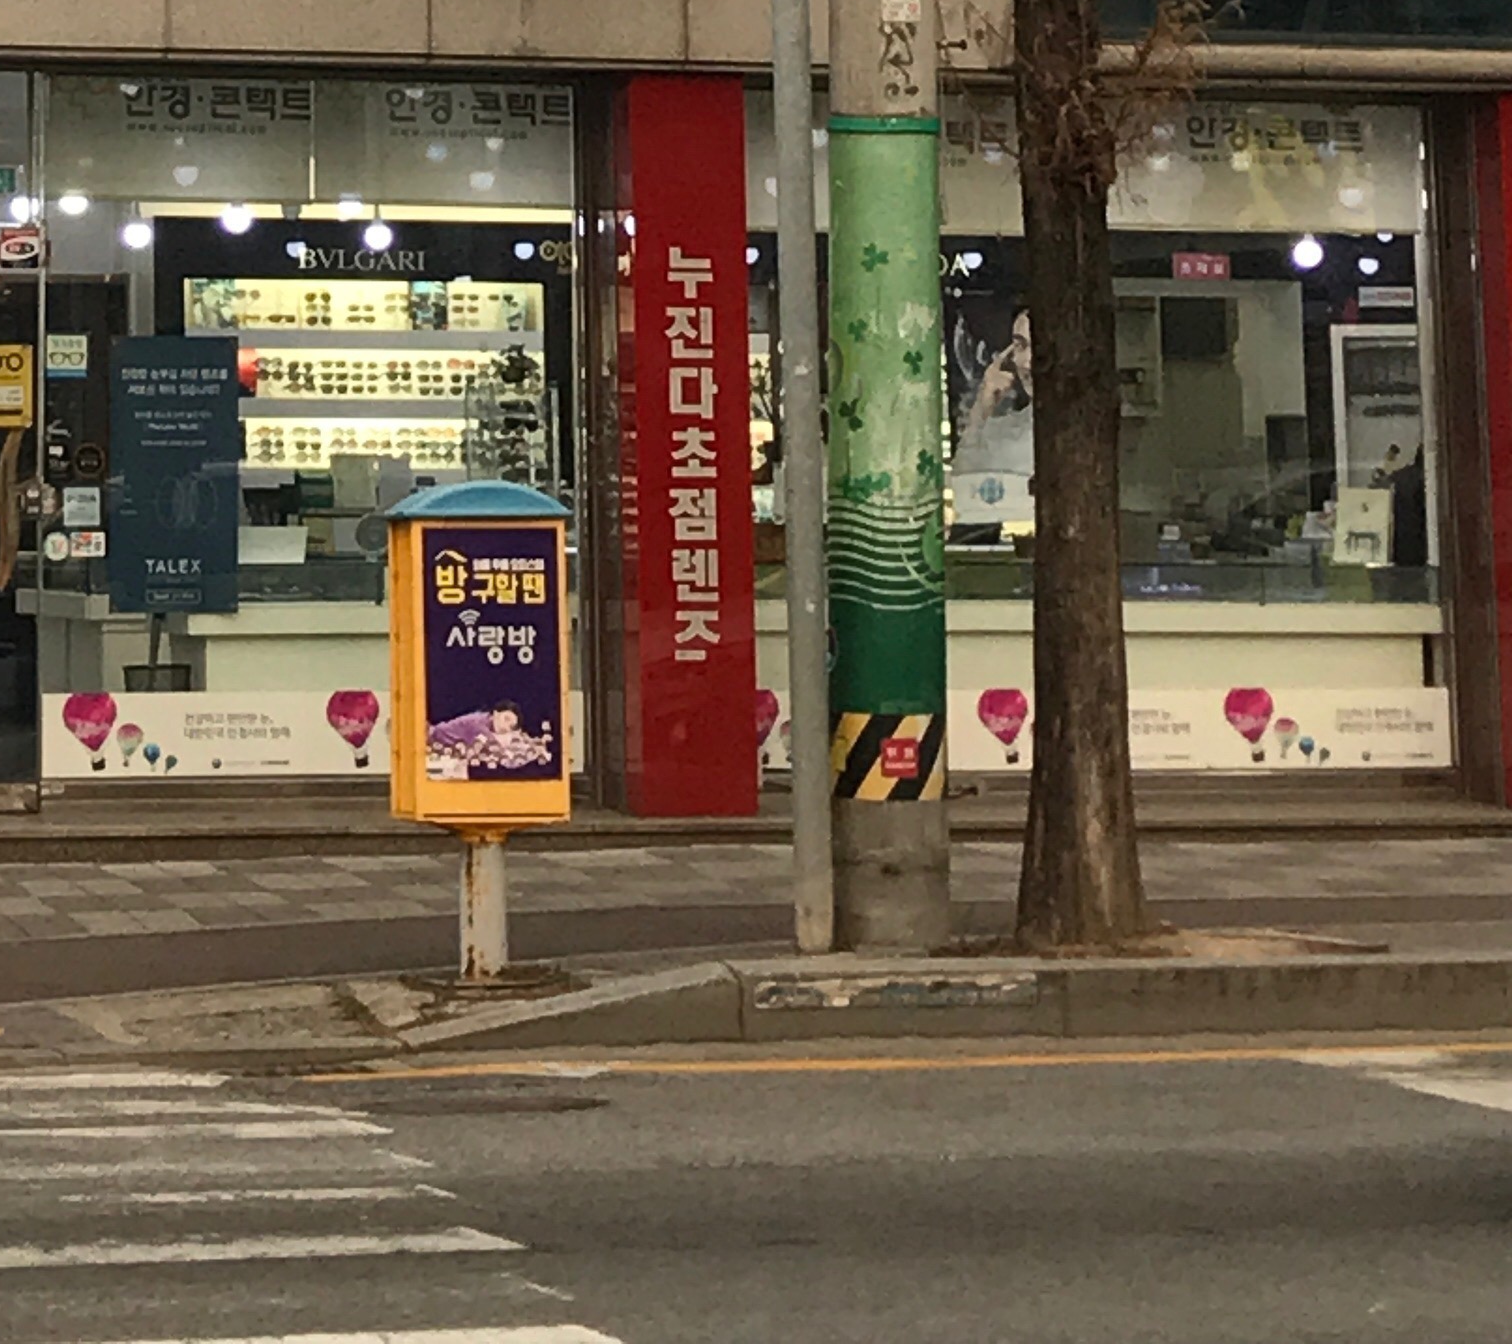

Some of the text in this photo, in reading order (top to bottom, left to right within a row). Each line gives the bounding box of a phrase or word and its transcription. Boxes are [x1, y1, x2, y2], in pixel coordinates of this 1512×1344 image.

[297, 247, 426, 271] BVLGARI
[664, 246, 721, 662] 누진다초점렌즈
[145, 558, 202, 575] TALEX
[445, 624, 537, 665] 사랑방
